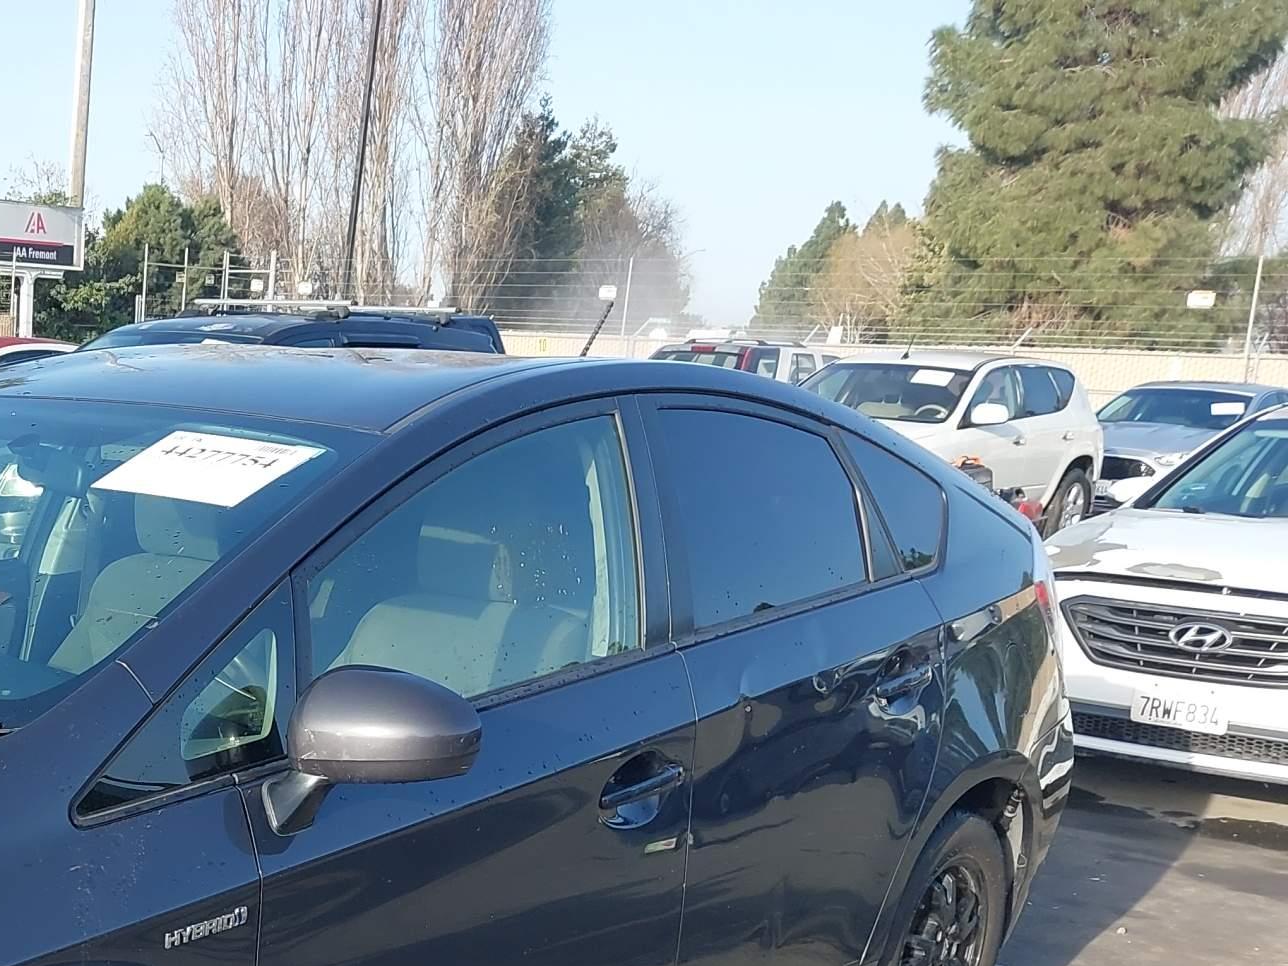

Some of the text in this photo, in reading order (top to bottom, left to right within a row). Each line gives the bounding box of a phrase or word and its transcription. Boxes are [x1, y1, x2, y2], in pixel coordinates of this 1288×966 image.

[28, 247, 57, 260] Fremont
[1140, 695, 1219, 725] 7RWF834
[164, 912, 235, 949] HYBRID
